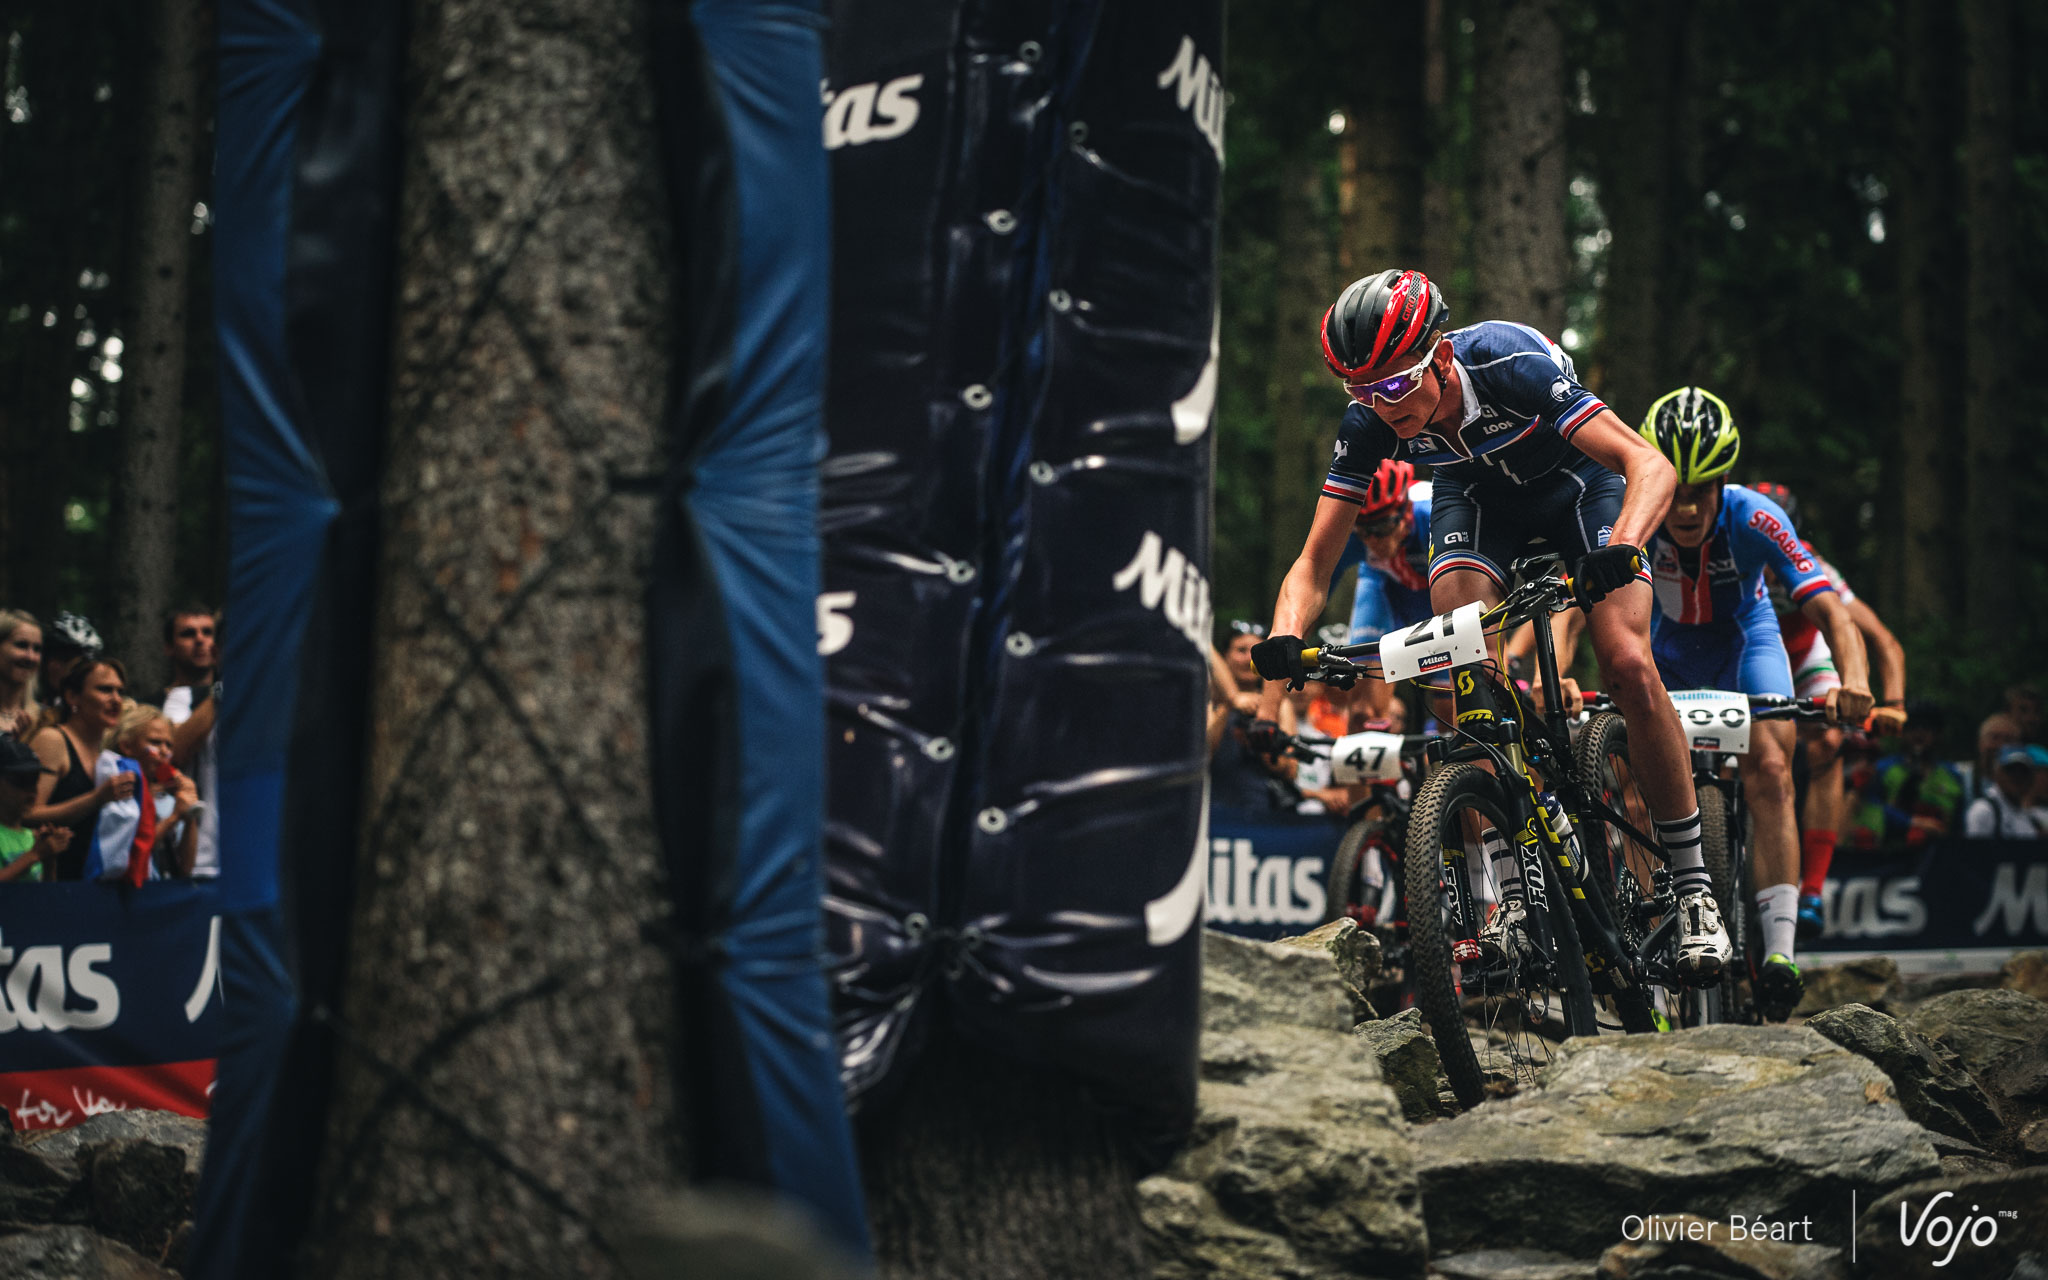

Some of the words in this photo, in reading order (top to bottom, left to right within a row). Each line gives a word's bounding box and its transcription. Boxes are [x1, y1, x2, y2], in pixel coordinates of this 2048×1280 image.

[1402, 295, 1416, 321] GIRO
[1421, 654, 1449, 667] Mitas
[1344, 746, 1387, 771] 47
[1521, 845, 1549, 912] FOX
